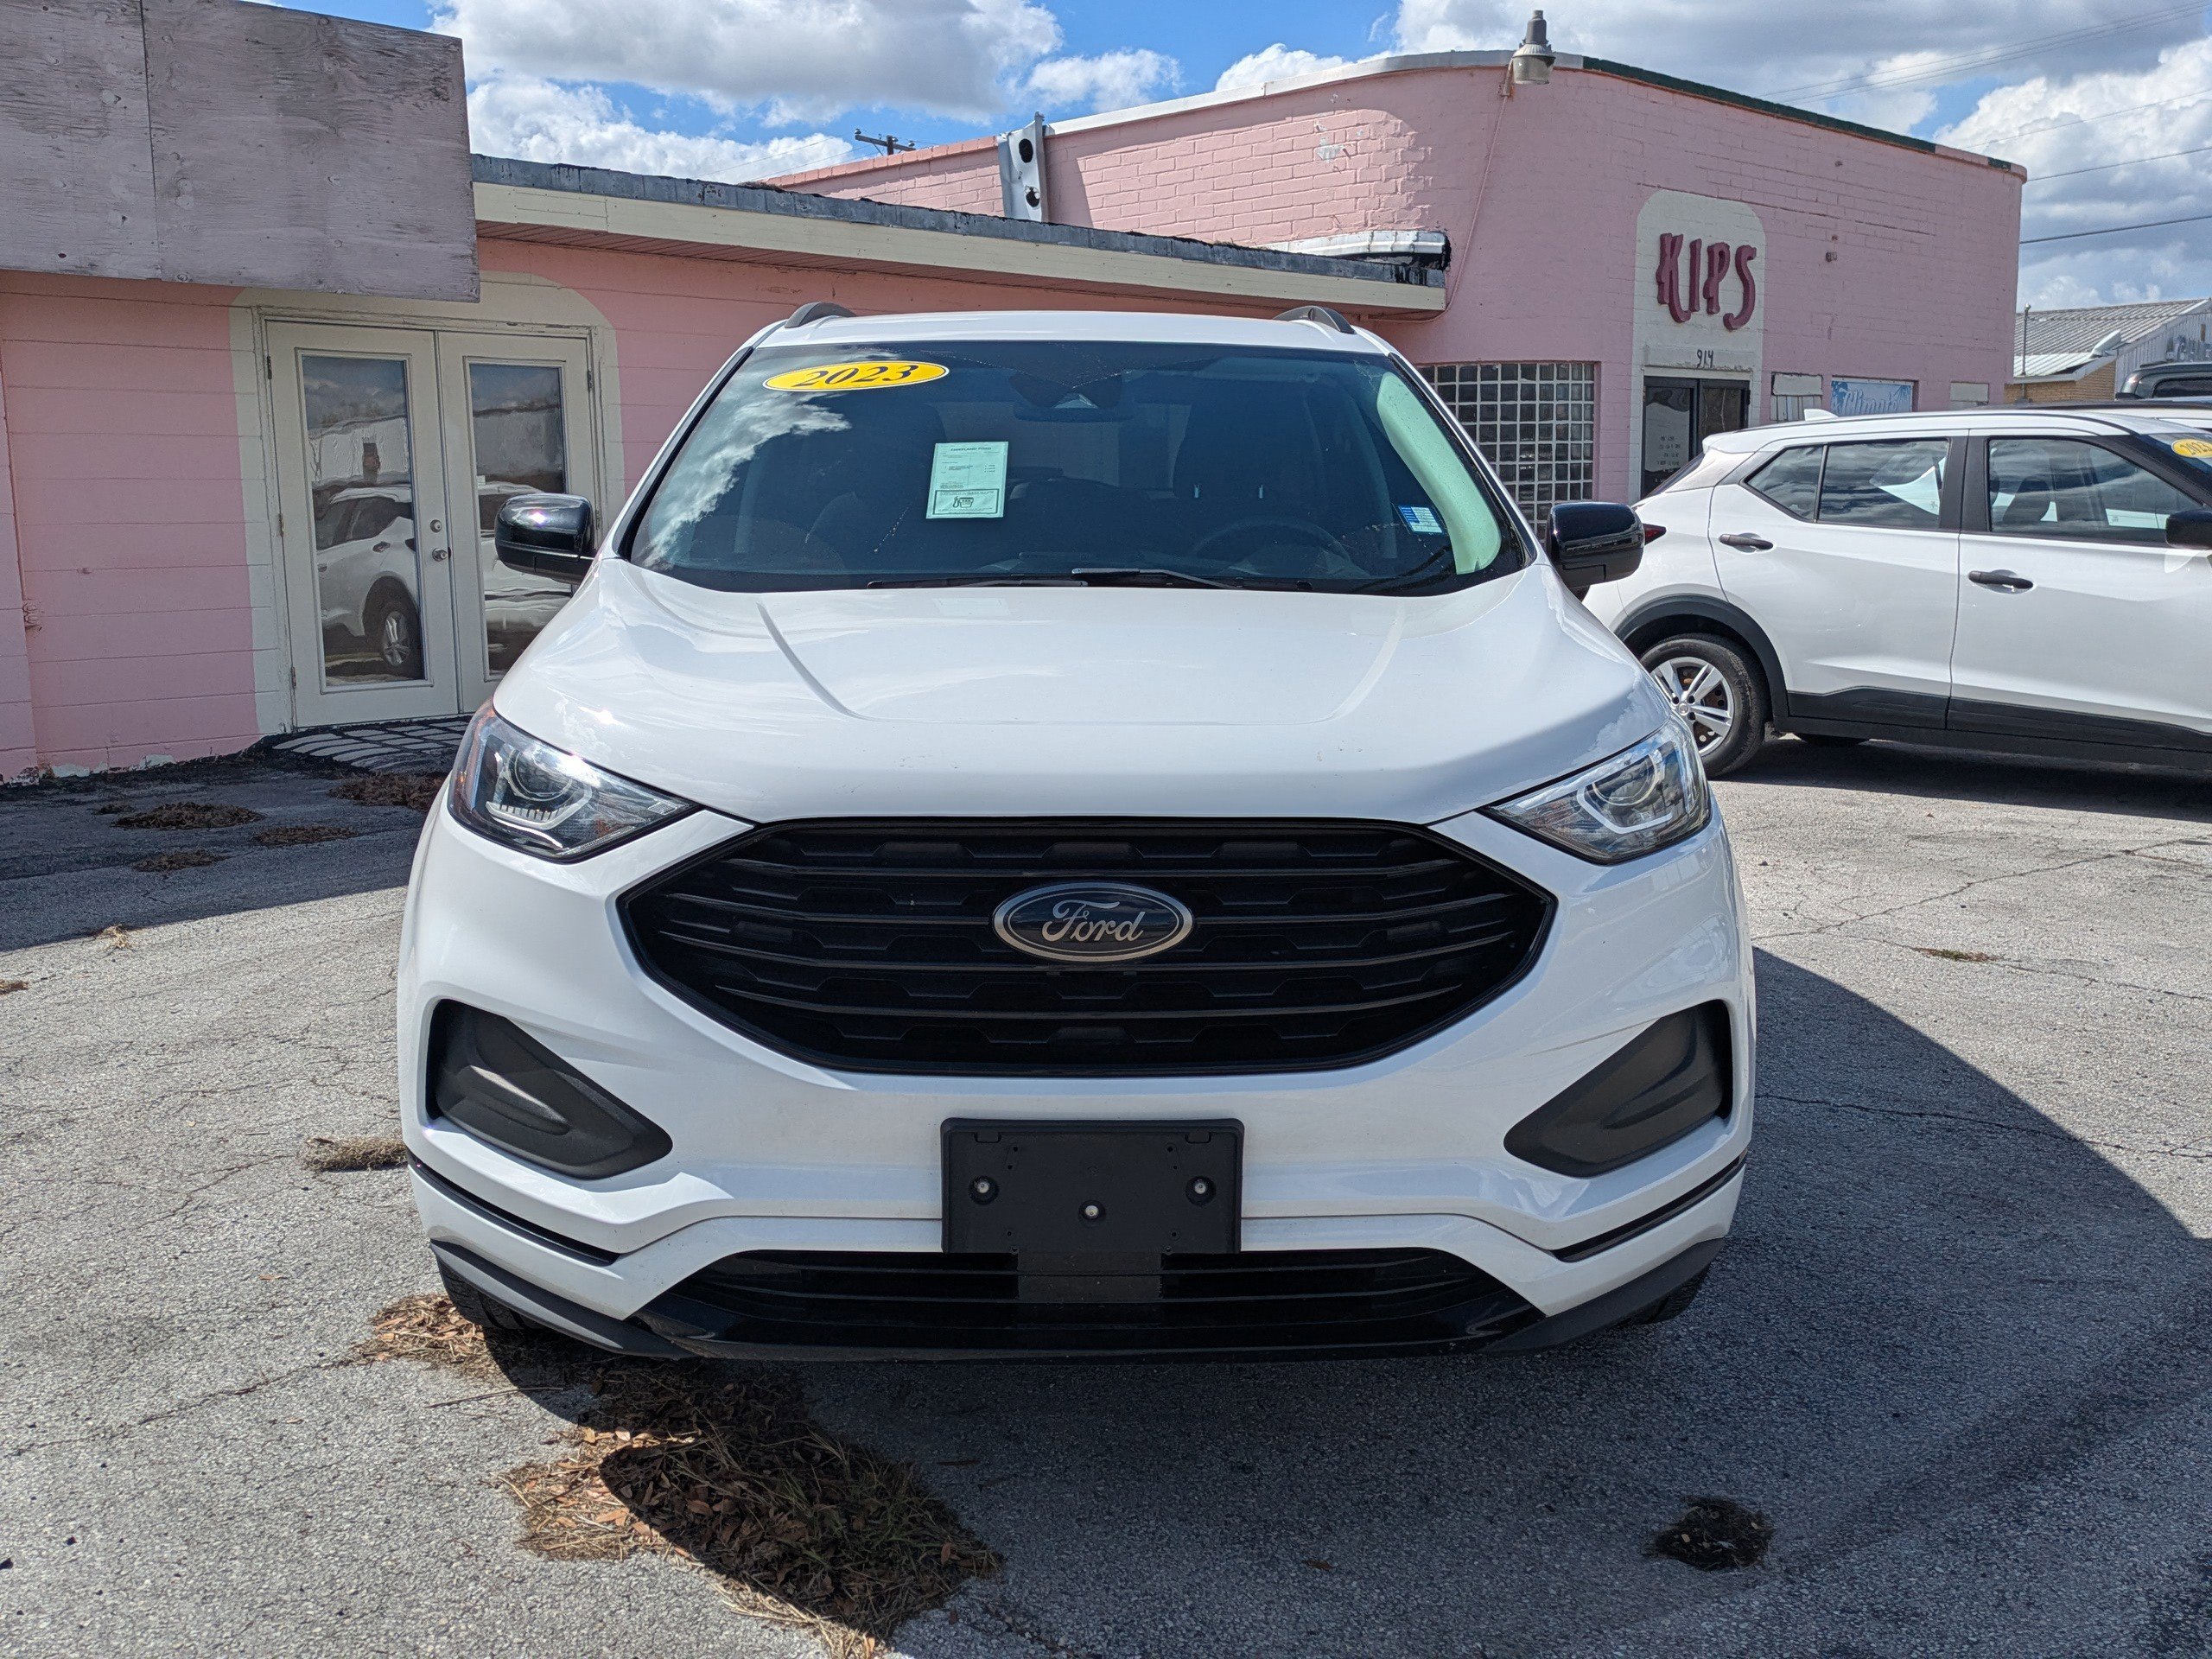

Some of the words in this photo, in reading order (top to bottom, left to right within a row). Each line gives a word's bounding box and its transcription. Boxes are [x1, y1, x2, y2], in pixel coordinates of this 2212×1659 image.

[1656, 232, 1757, 332] KIPS
[1696, 349, 1714, 369] 914
[791, 364, 919, 388] 2023
[1041, 899, 1145, 942] Ford
